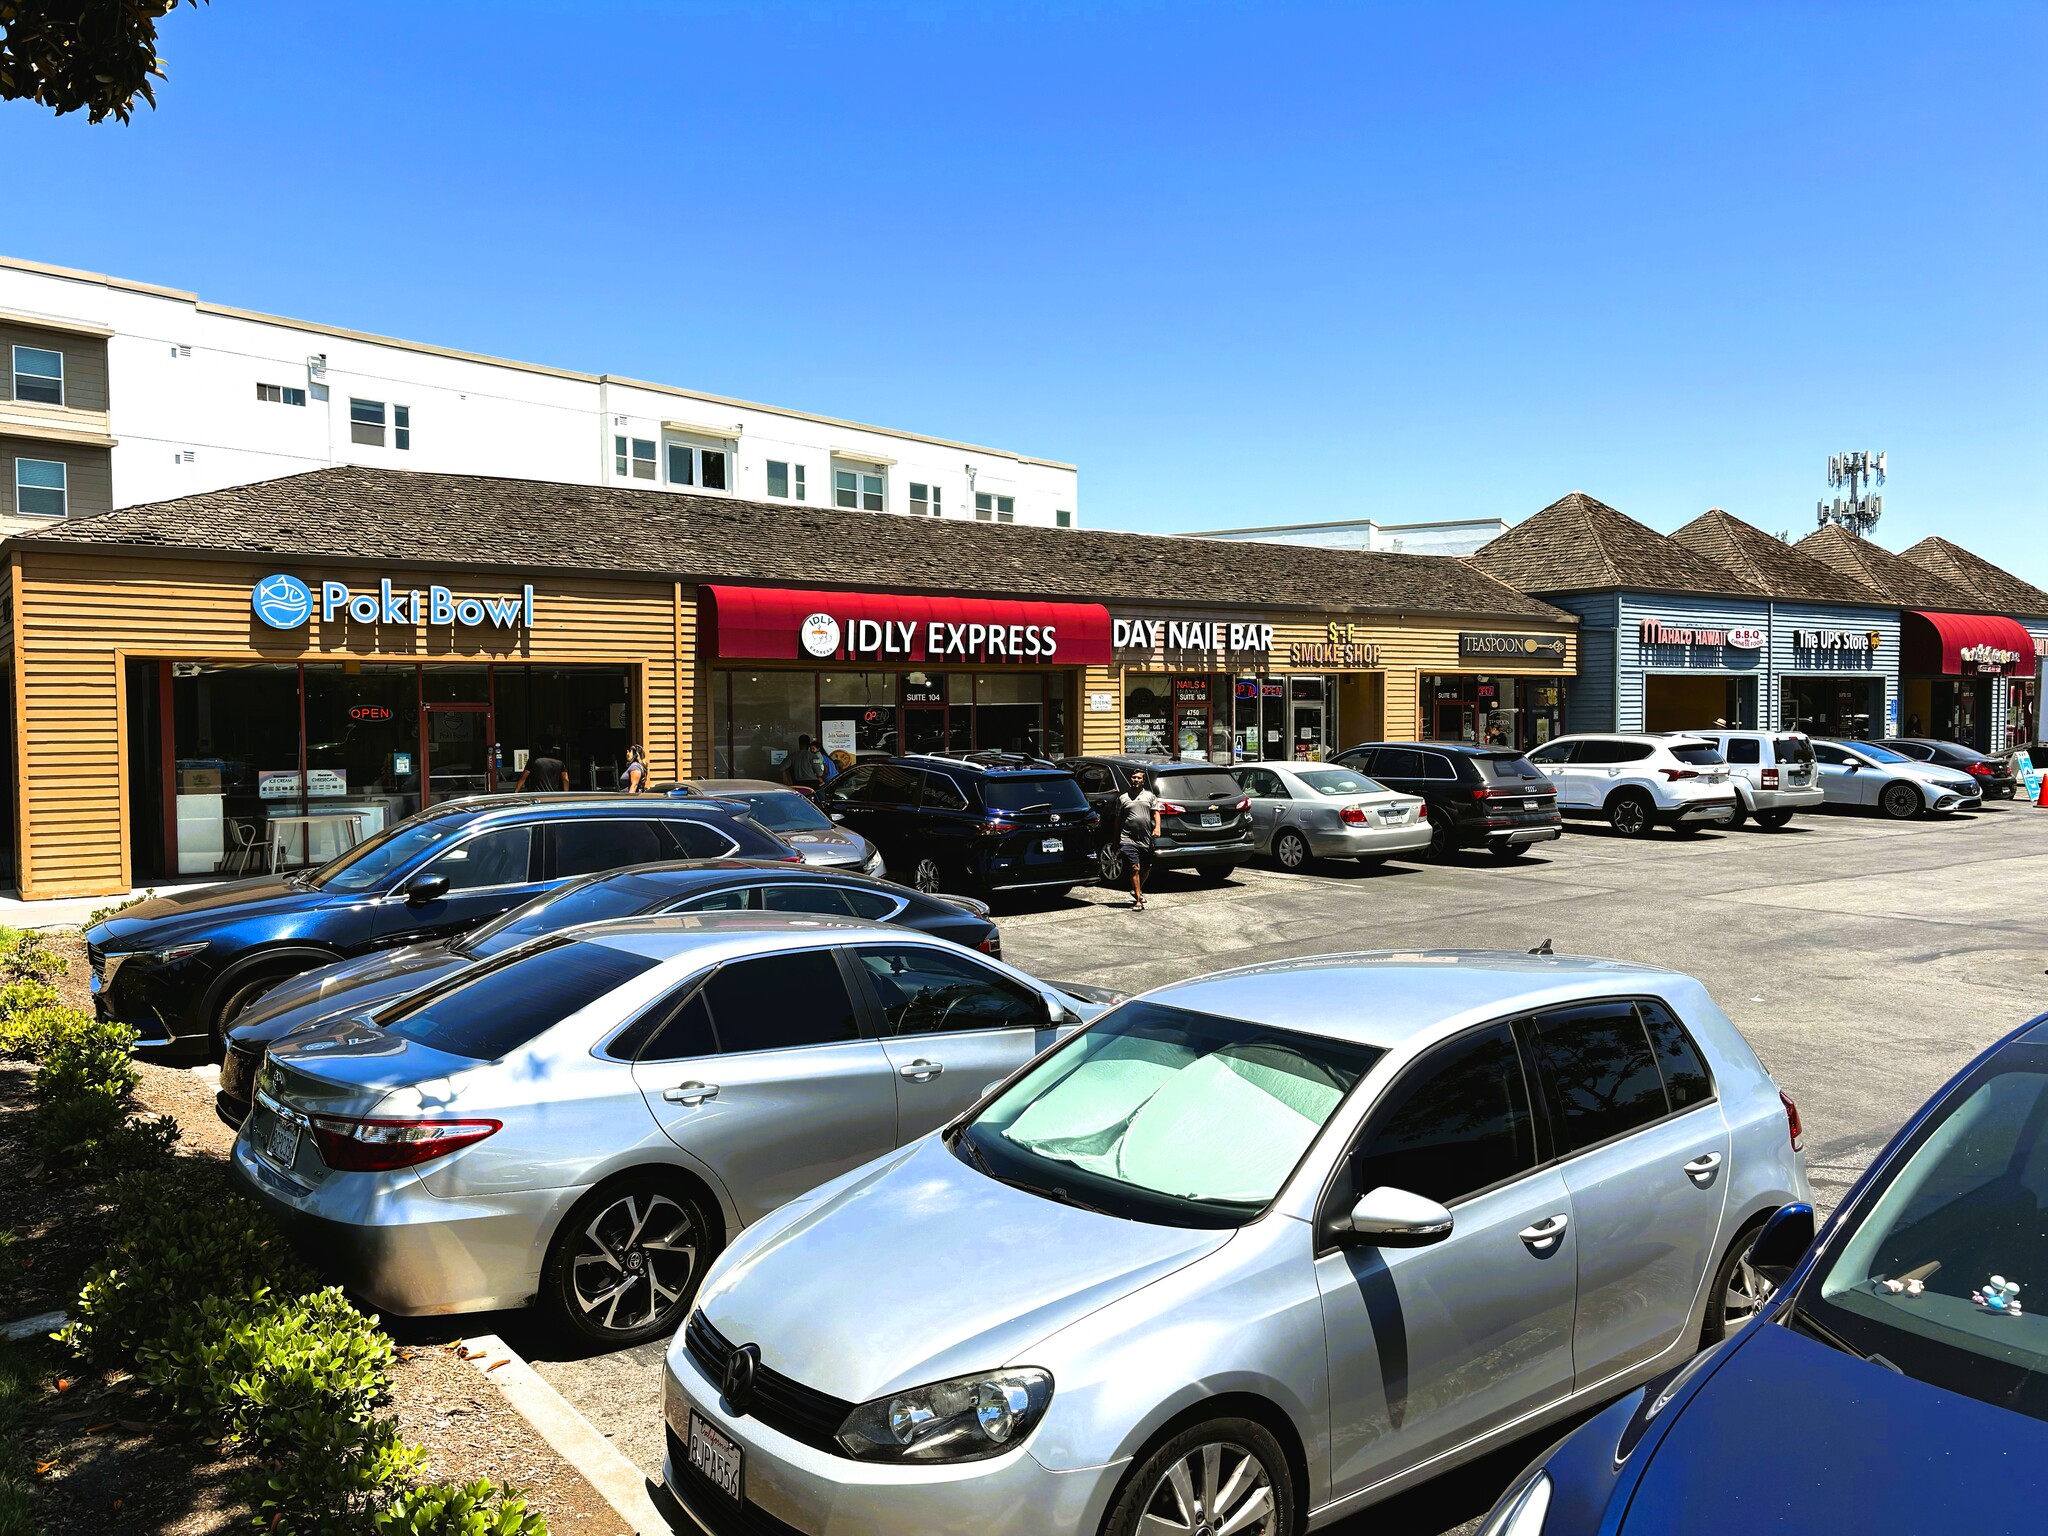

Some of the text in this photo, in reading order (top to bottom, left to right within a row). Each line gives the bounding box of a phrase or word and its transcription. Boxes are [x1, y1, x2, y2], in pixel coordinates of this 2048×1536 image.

[322, 578, 534, 629] Poki Bowl
[809, 615, 834, 627] IDLY
[848, 619, 1057, 656] IDLY EXPRESS
[1113, 619, 1275, 651] DAY NAIL BAR
[1695, 629, 1727, 646] HAWAII
[1735, 630, 1760, 639] B.B.Q
[1798, 629, 1869, 650] The UPS Store
[1464, 636, 1524, 653] TEASPOON
[1750, 639, 1764, 647] FOOD
[1292, 642, 1382, 663] SMOKE SHOP
[1177, 681, 1199, 689] NAILS
[906, 693, 940, 701] SUITE 104
[1179, 693, 1206, 701] SUITE 108
[350, 708, 390, 719] OPEN
[864, 710, 887, 722] OPEN
[690, 1433, 738, 1497] 8JPA556
